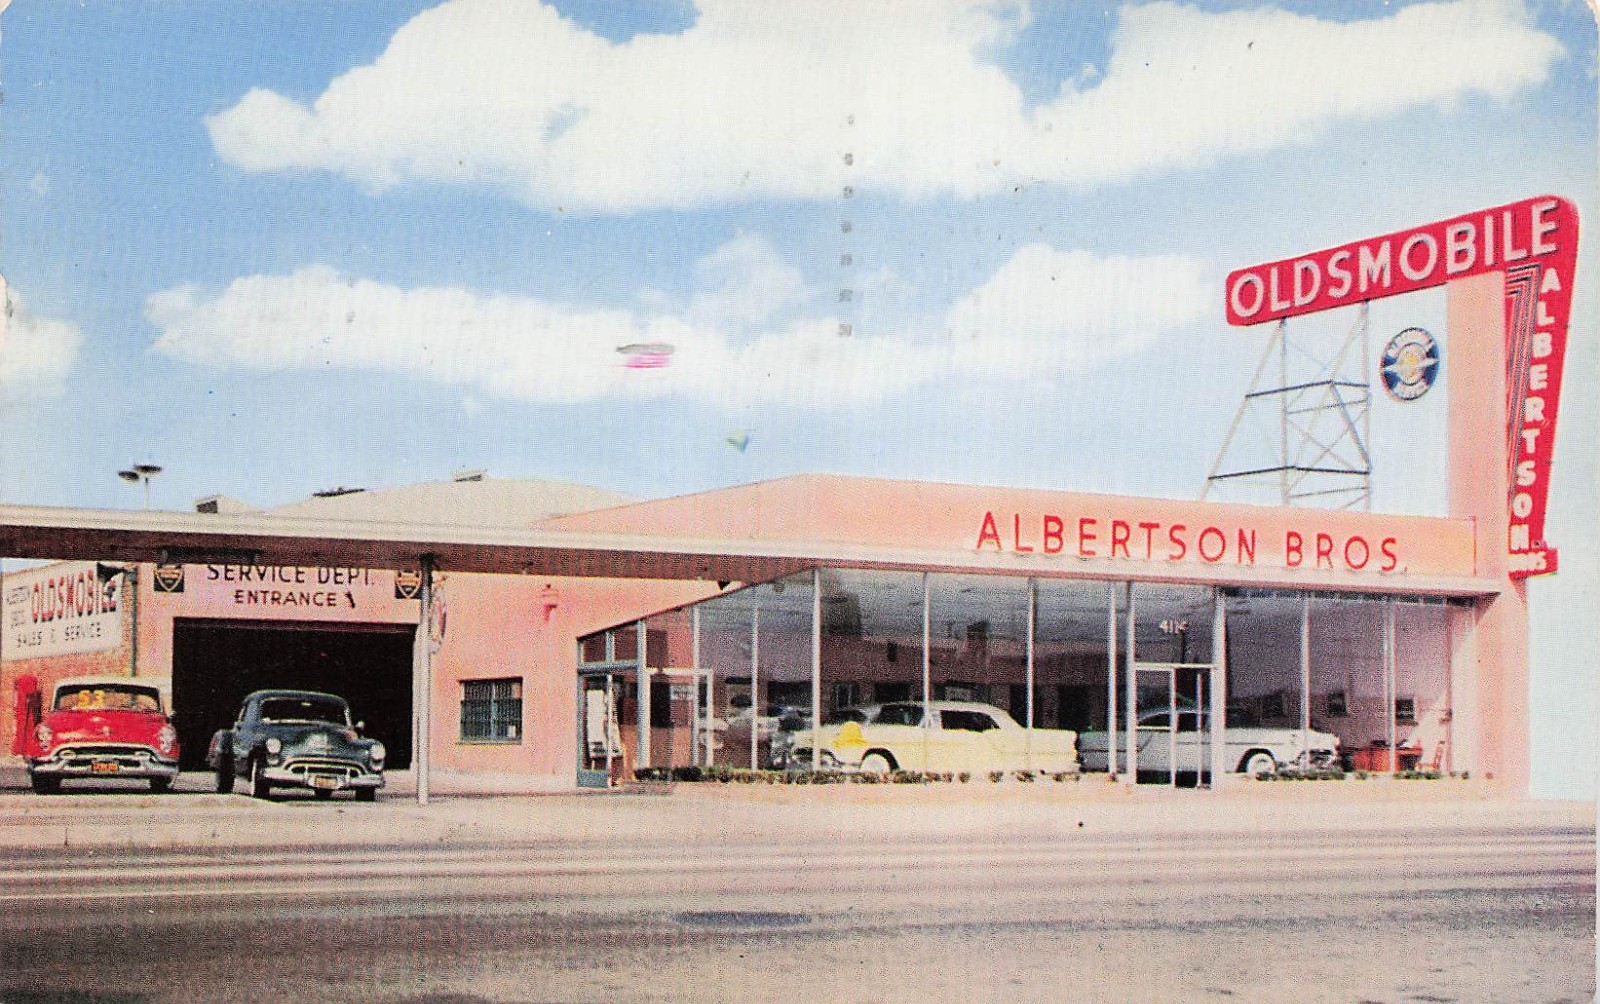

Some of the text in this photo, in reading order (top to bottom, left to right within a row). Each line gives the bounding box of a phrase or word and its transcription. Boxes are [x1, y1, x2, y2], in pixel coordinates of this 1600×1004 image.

[1230, 200, 1559, 318] OLDSMOBILE
[976, 510, 1256, 565] ALBERTSON
[32, 570, 117, 624] OLDSMOBILE
[207, 564, 306, 584] SERVICE
[234, 589, 337, 607] ENTRANCE
